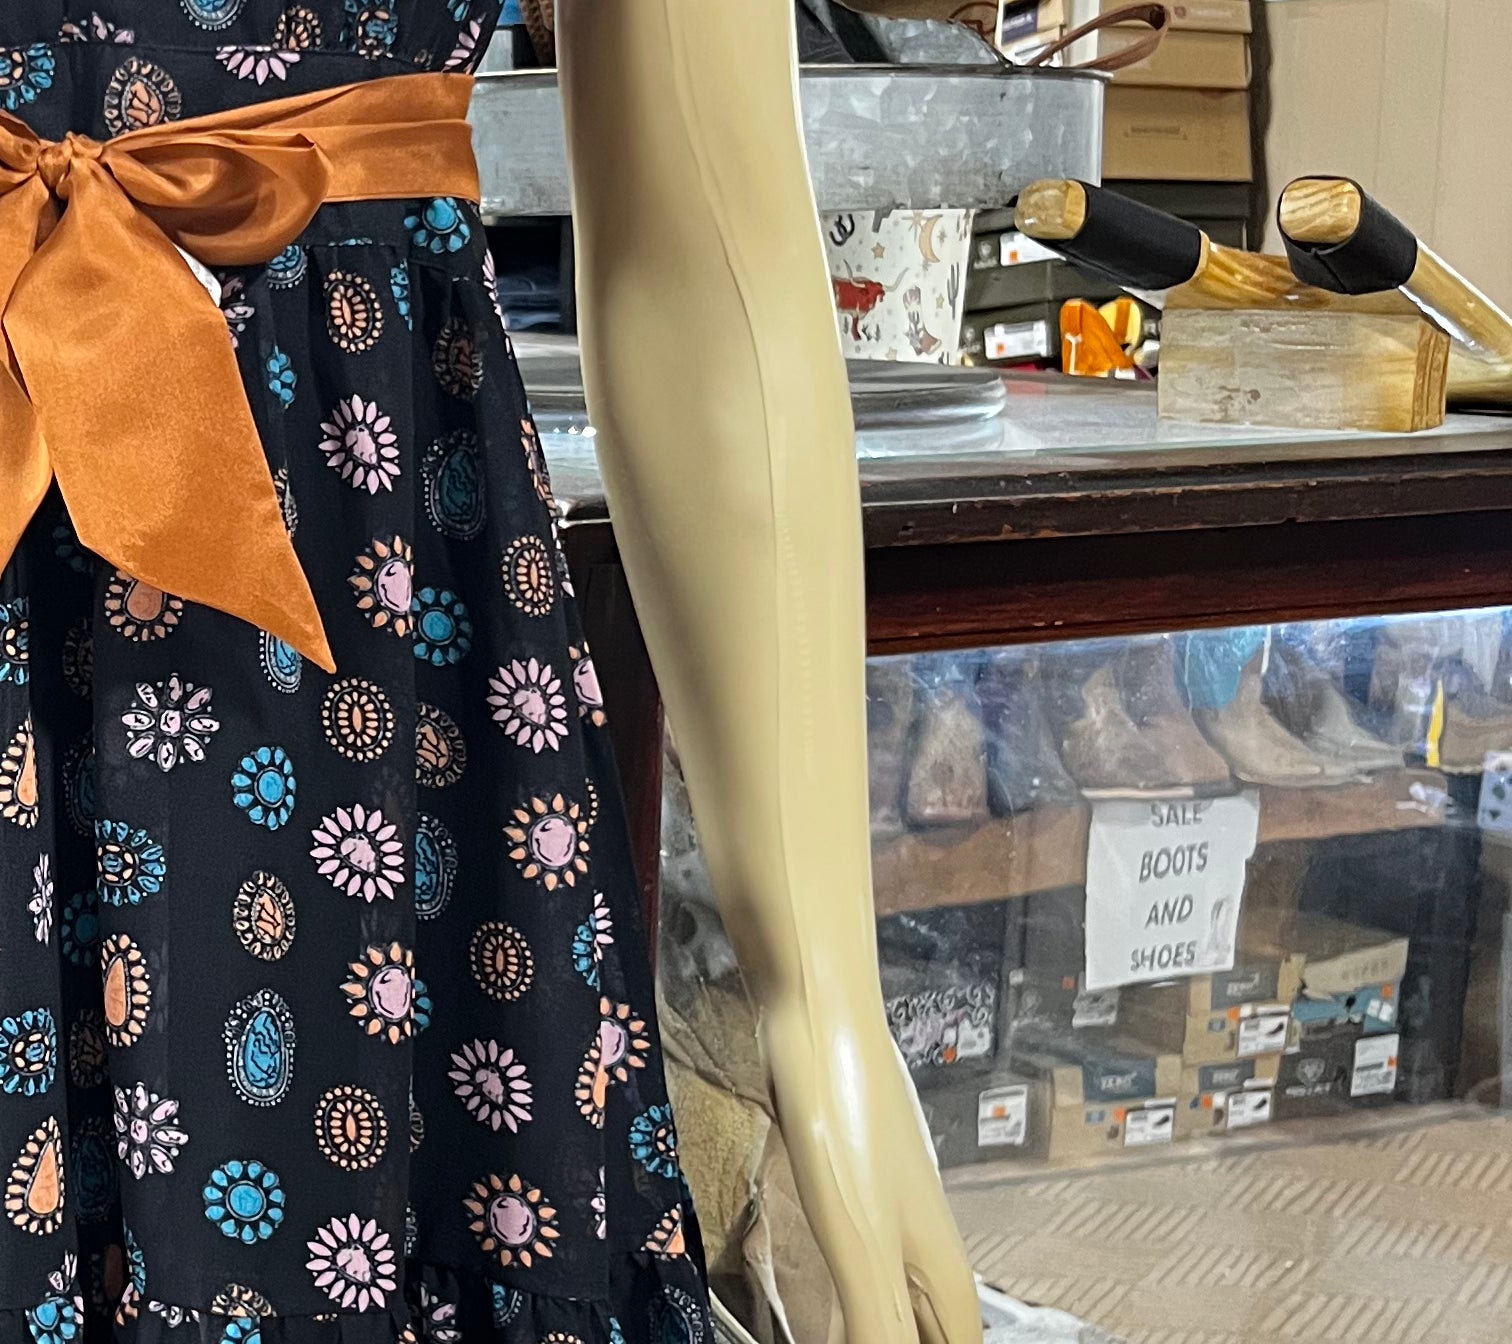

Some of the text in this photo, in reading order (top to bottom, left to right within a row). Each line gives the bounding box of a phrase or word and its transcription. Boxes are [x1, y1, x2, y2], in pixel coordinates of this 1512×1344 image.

[1151, 802, 1203, 828] SALE
[1139, 841, 1209, 884] BOOTS
[1144, 893, 1194, 930] AND
[1130, 940, 1198, 973] SHOES
